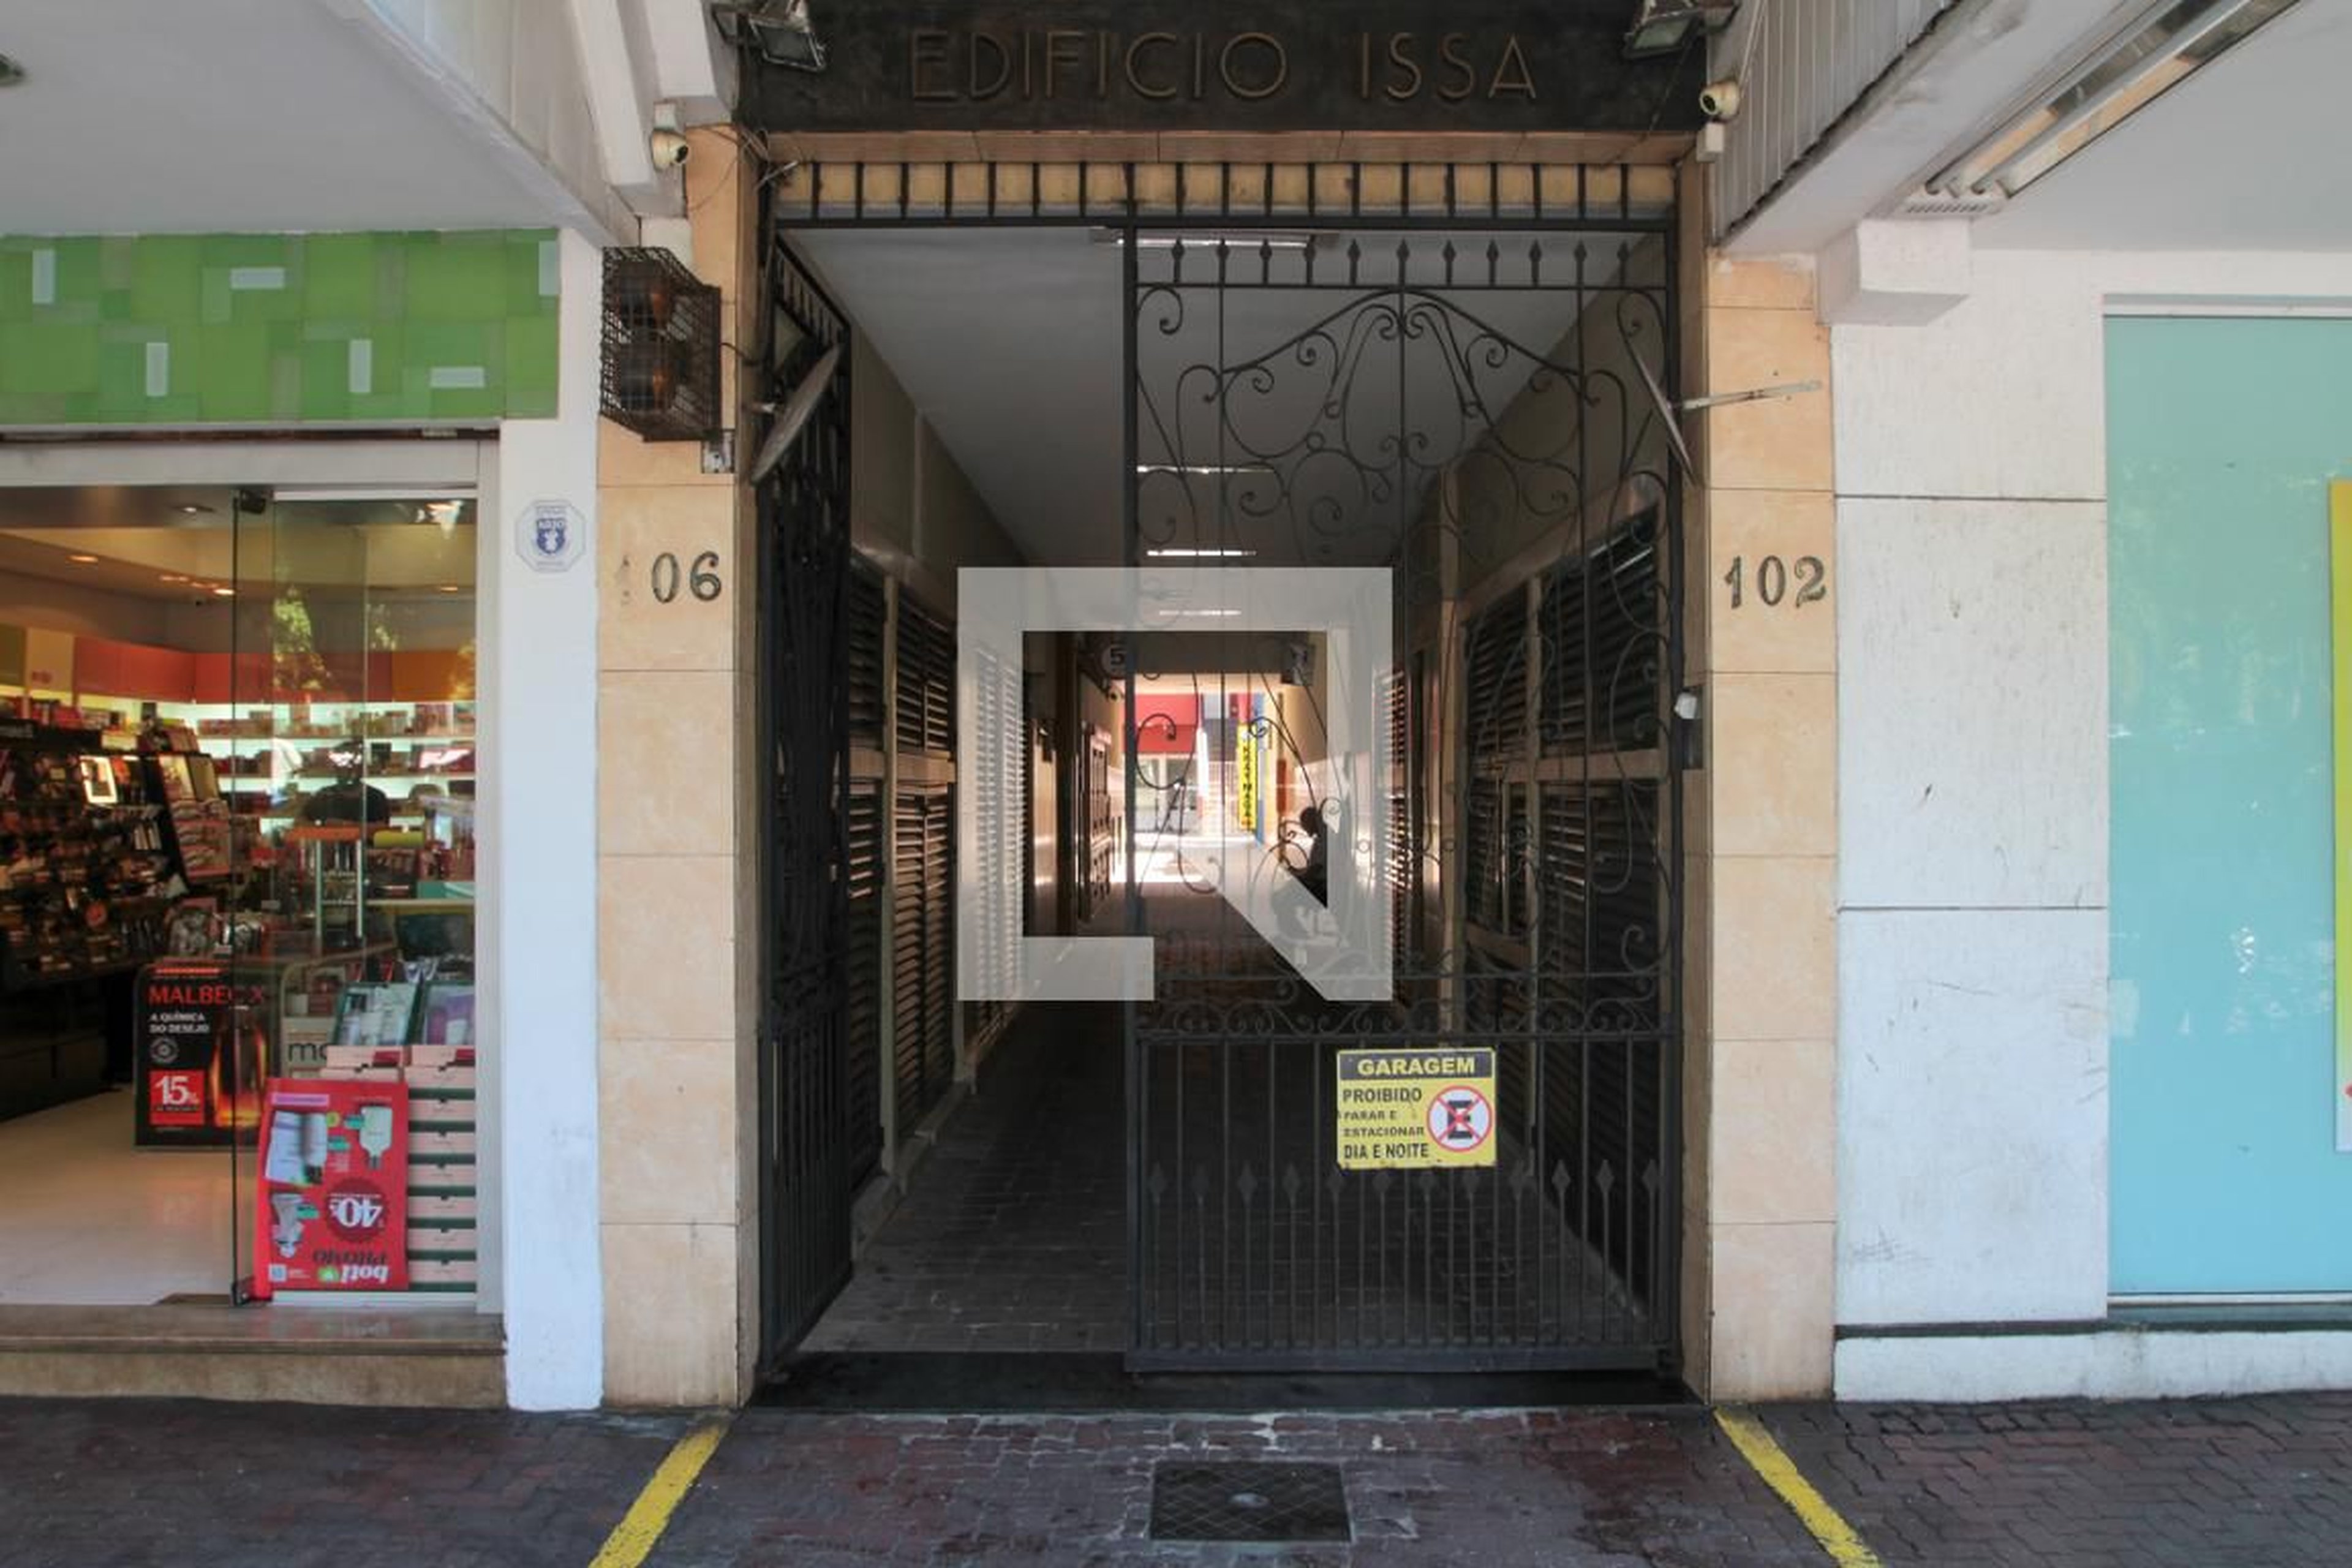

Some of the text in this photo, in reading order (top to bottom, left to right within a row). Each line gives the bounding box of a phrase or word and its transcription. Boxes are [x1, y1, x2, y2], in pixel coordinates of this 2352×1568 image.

[910, 32, 1538, 99] EDIFICIO ISSA
[1724, 554, 1826, 609] 102
[1357, 1057, 1476, 1076] GARAGEM
[1342, 1087, 1423, 1102] PROIBIDO
[1343, 1110, 1397, 1120] PARAR E
[1343, 1126, 1425, 1137] ESTACIONAR
[1343, 1143, 1430, 1159] DIA E NOITE
